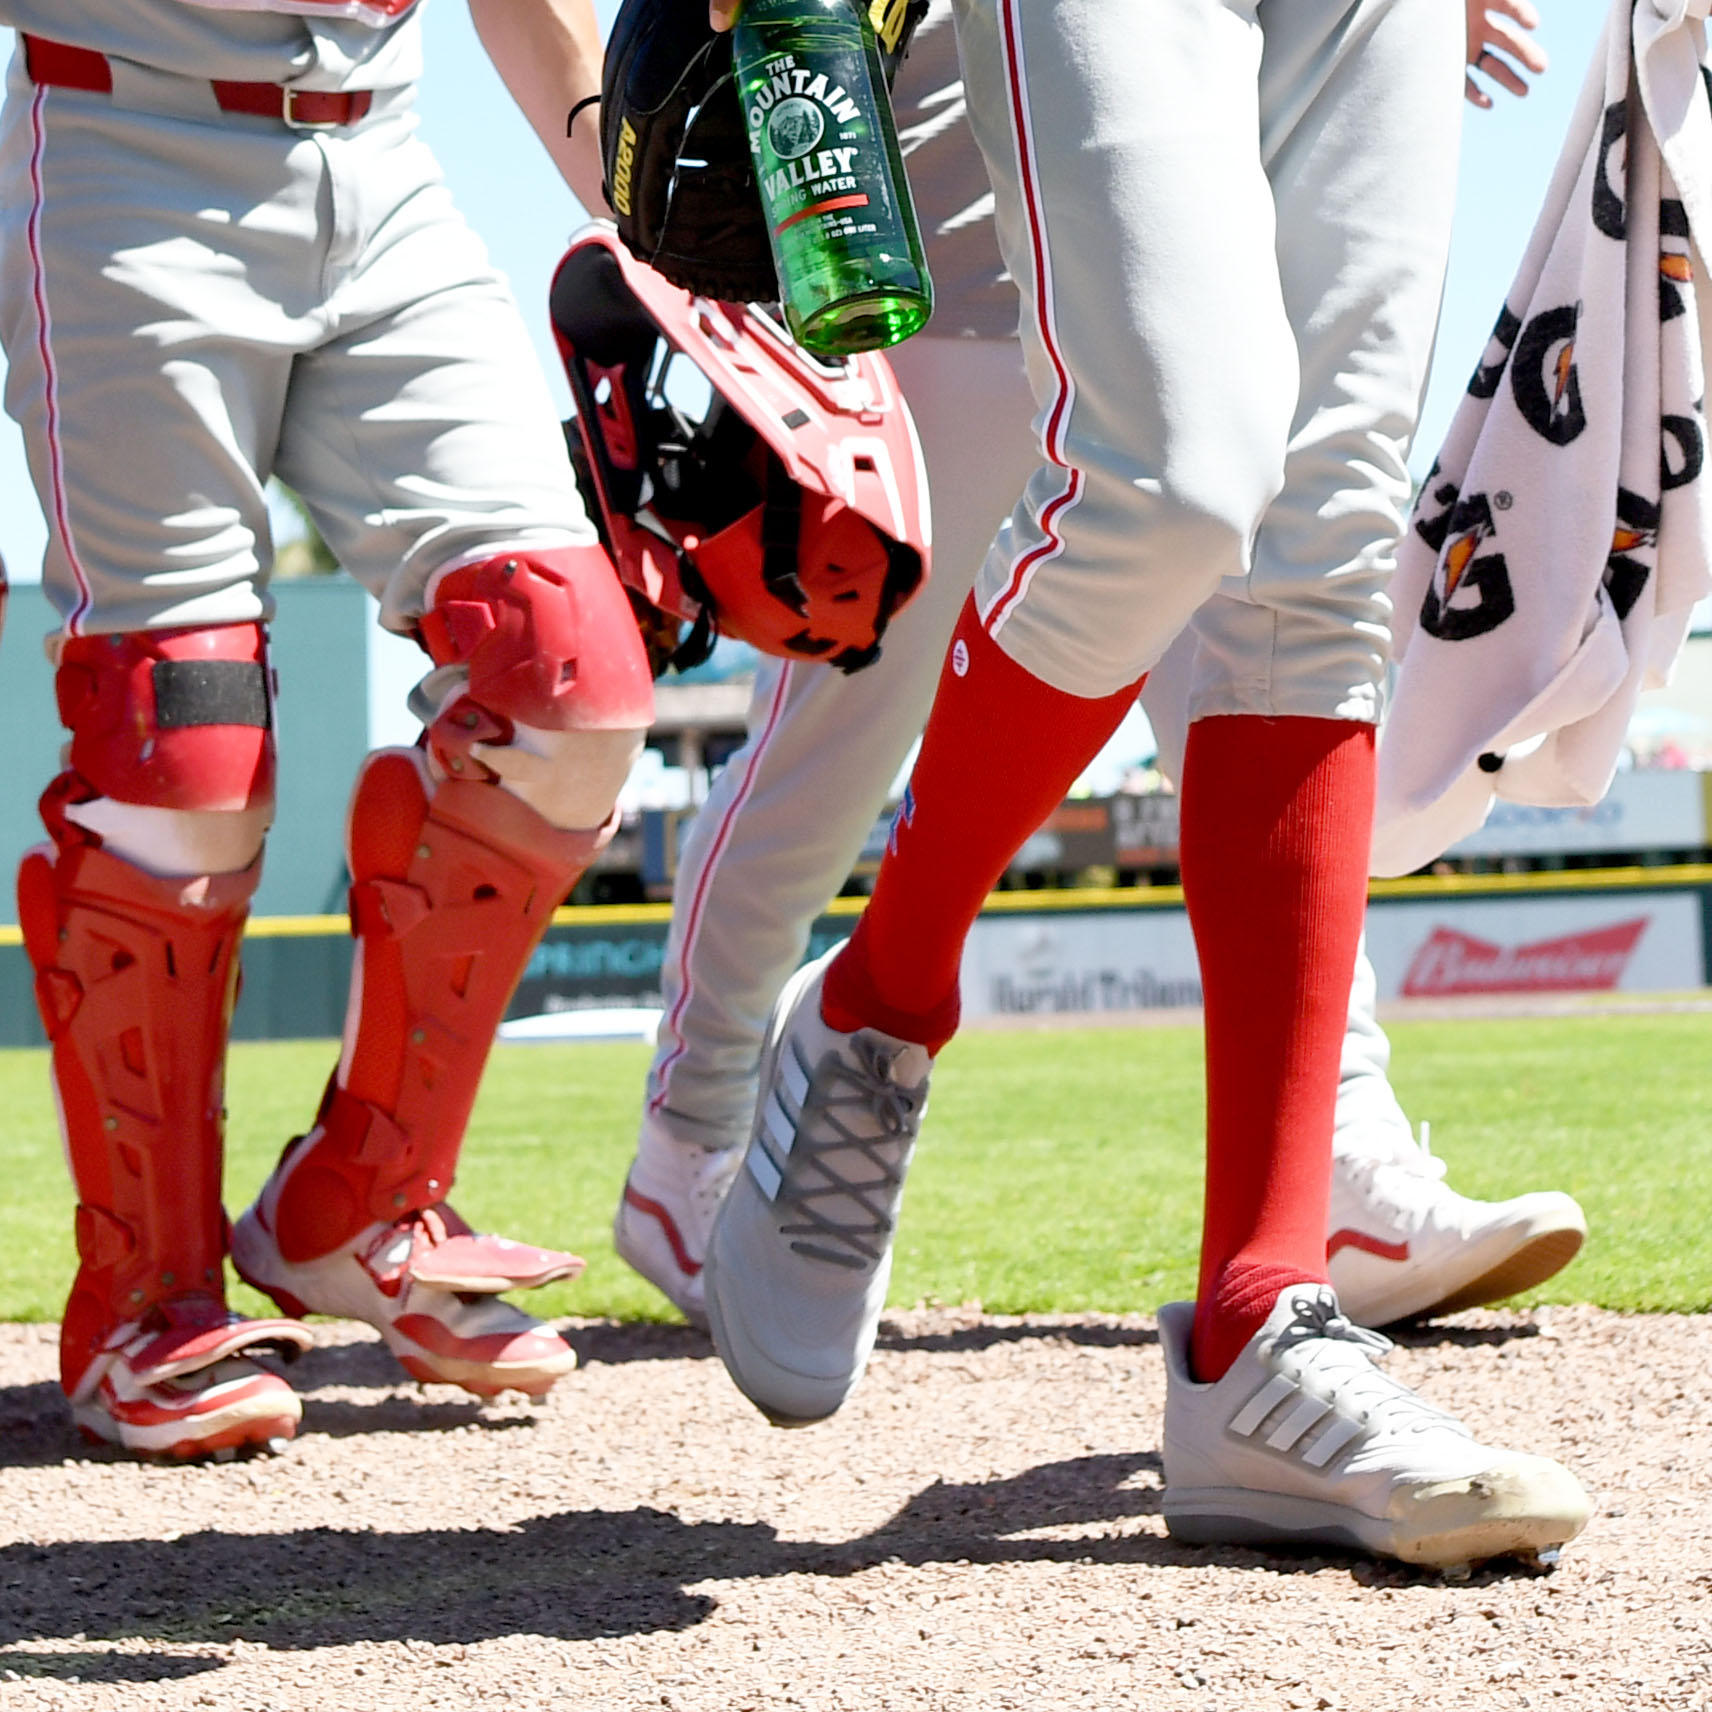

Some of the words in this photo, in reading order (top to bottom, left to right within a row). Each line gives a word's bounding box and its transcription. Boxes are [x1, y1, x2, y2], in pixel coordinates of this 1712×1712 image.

[765, 54, 796, 76] THE
[749, 68, 861, 154] MOUNTAIN
[613, 115, 637, 216] A2000
[764, 146, 859, 202] VALLEY
[811, 176, 857, 197] WATER
